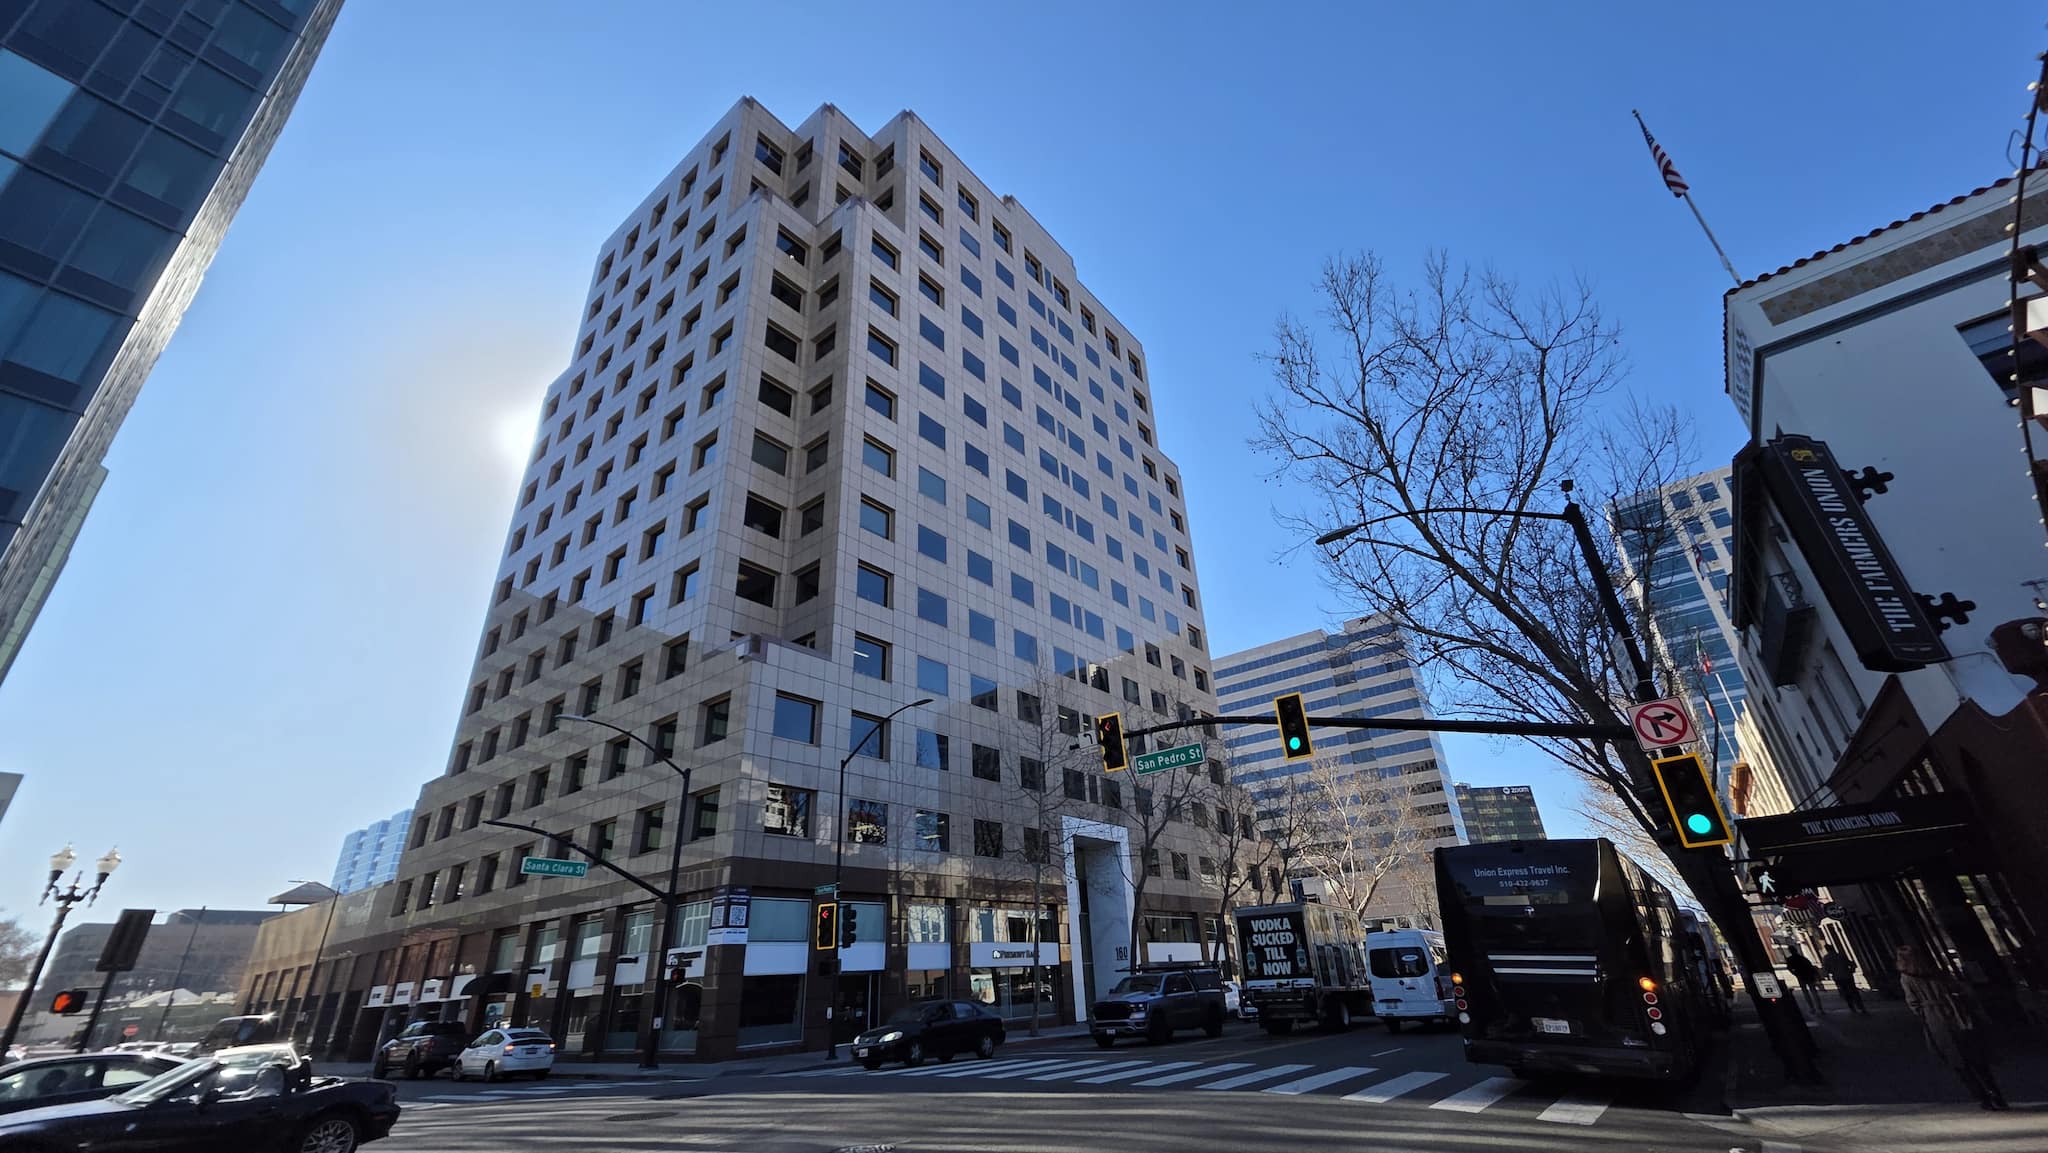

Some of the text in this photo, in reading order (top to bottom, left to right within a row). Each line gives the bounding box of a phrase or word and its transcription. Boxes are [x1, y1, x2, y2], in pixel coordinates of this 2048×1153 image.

[1800, 467, 1916, 632] THE FARMERS UNION
[1138, 748, 1201, 771] San Pedro St
[1802, 811, 1902, 835] THE FARMERS UNION
[525, 861, 585, 875] Santa Clara St
[1474, 864, 1571, 878] Union Express Travel Inc.
[1251, 917, 1292, 933] VODKA
[1252, 931, 1295, 947] SUCKED
[1115, 946, 1129, 960] 160
[1263, 946, 1288, 961] TILL
[1262, 961, 1292, 976] NOW
